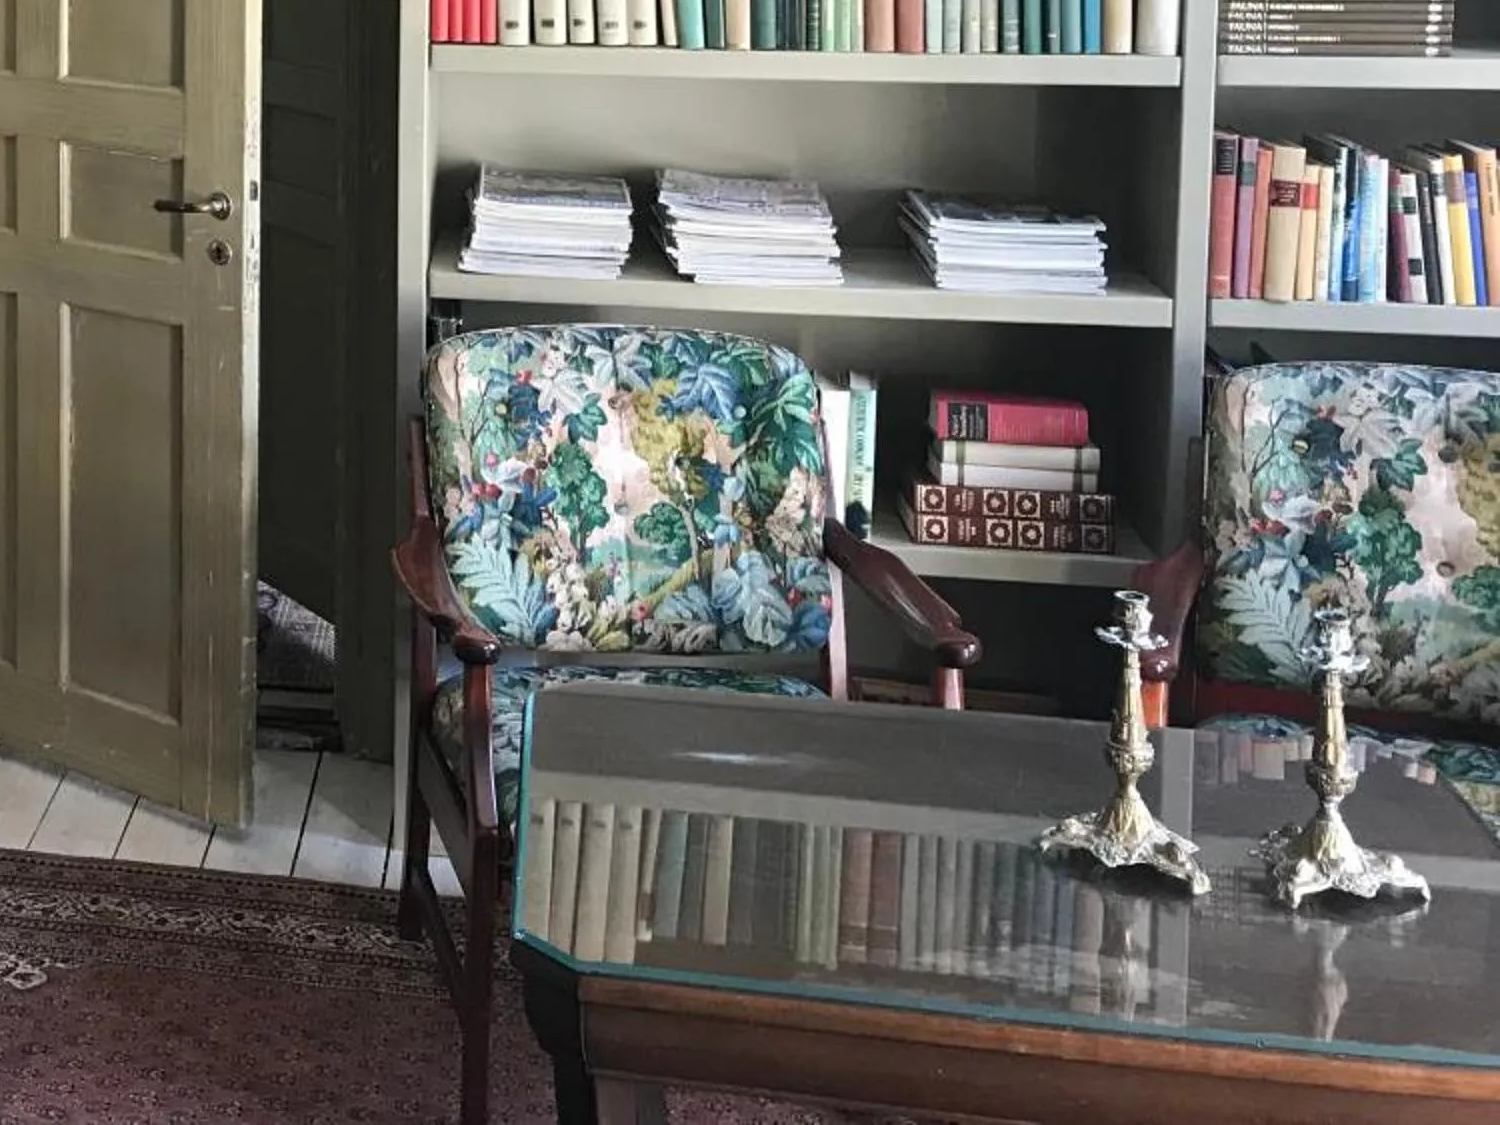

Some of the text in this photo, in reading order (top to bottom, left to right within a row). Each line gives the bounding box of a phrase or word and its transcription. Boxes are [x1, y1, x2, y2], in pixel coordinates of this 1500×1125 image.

[1230, 2, 1264, 12] FAUNA
[1229, 22, 1263, 32] FAUNA
[1228, 44, 1263, 54] FAUNA
